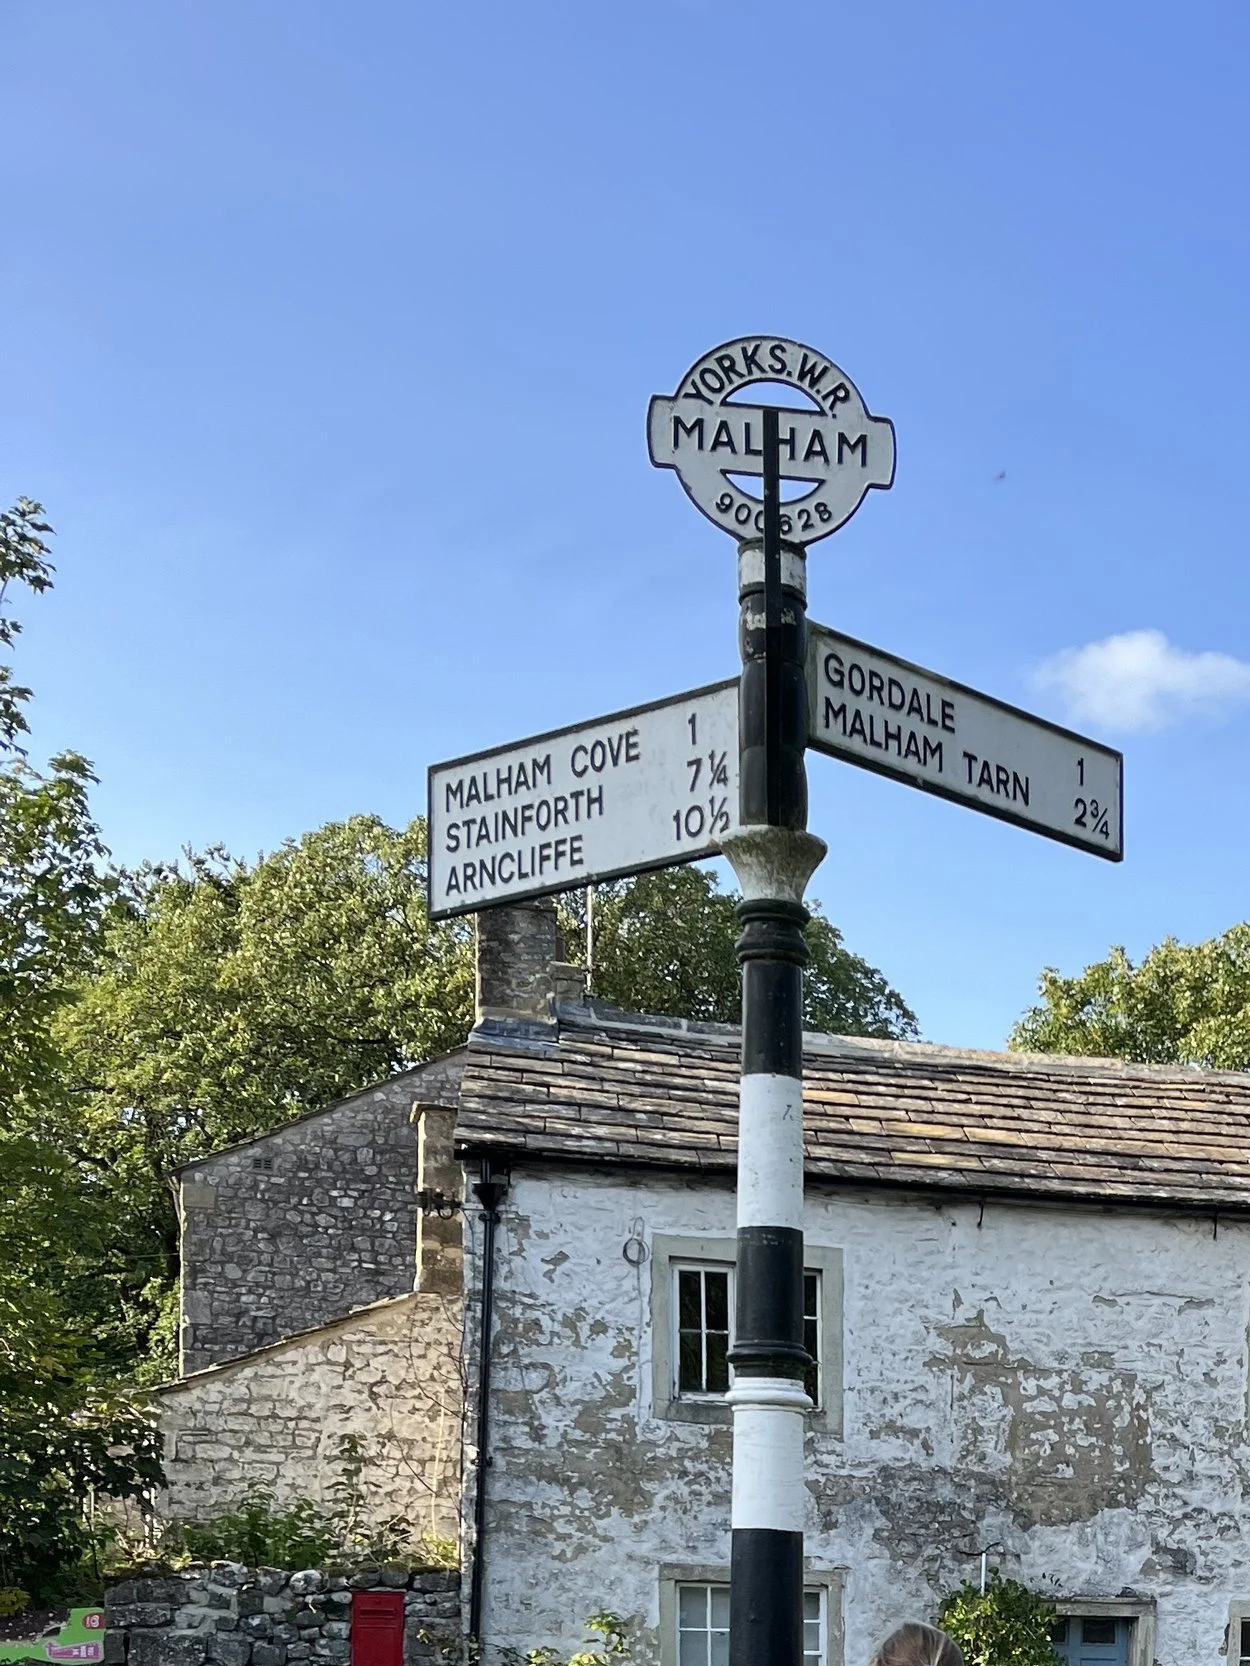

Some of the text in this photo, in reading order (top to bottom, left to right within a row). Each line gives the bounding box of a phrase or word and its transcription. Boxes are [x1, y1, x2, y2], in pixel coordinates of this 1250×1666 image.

[672, 415, 868, 468] MALHAM
[823, 652, 1085, 786] GORDALE 1
[823, 695, 944, 773] MALHAM
[962, 750, 1031, 807] TARN
[445, 712, 698, 813] MALHAM COVE 1
[445, 784, 605, 853] STAINFORTH
[445, 834, 585, 897] ARNCLIFFE
